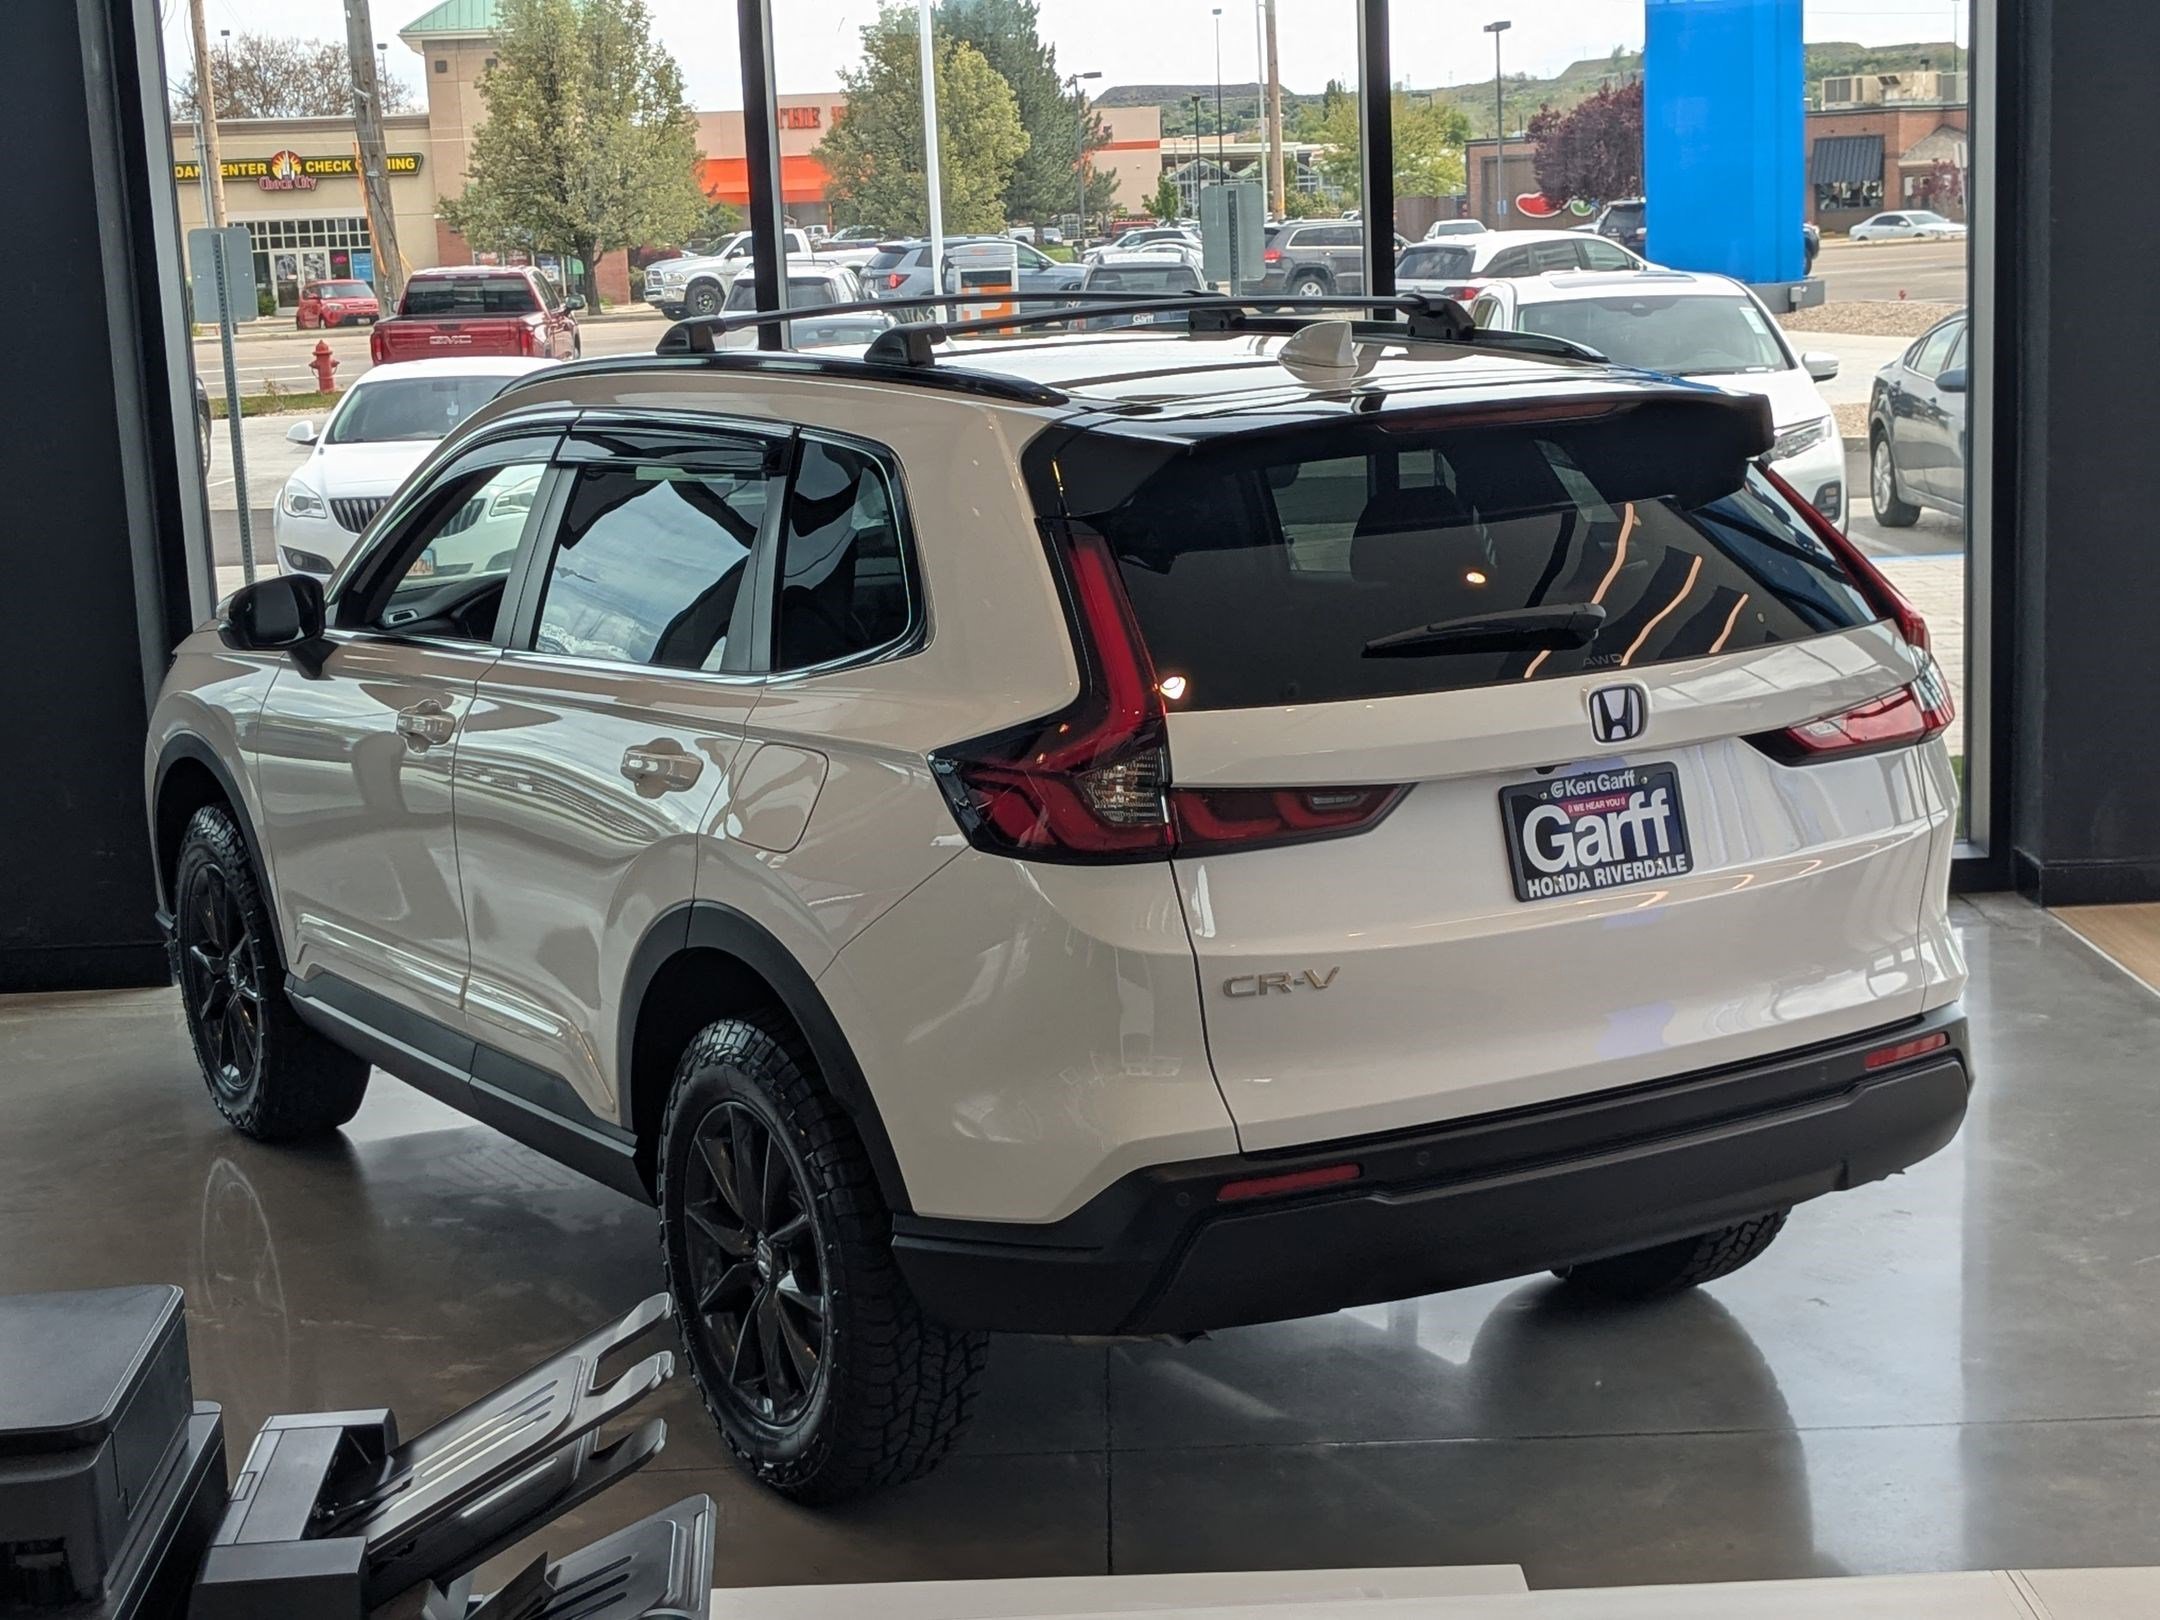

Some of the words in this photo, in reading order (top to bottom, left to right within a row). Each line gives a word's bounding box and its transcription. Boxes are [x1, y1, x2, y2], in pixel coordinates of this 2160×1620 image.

[220, 163, 267, 176] ENTER
[305, 160, 352, 173] CHECK
[1582, 652, 1624, 667] AWD
[1564, 780, 1597, 797] Ken
[1597, 769, 1636, 792] Garff
[1573, 802, 1585, 813] WE
[1585, 799, 1605, 811] HEAR
[1605, 798, 1620, 808] YOU
[1522, 787, 1671, 873] Garff
[1527, 874, 1590, 898] HONDA
[1594, 854, 1688, 887] RIVERDALE
[1222, 965, 1341, 998] CR-V
